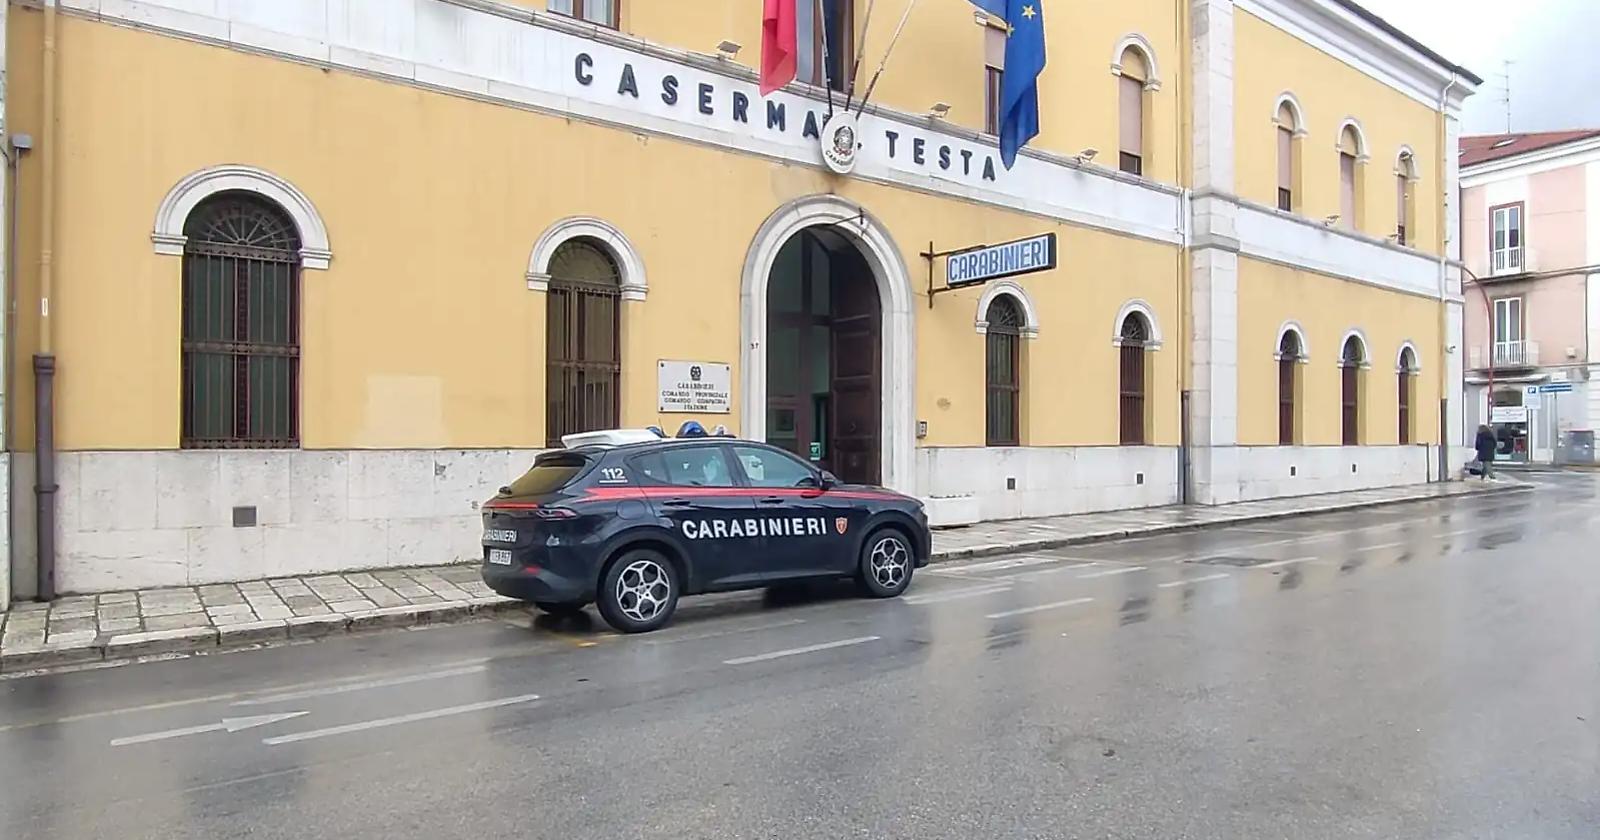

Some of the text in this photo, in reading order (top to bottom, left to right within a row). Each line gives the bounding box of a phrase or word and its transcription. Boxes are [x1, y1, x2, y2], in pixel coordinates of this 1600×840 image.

[575, 52, 819, 139] CASERMA
[885, 130, 996, 181] TESTA
[949, 238, 1047, 281] CARABINIERI
[601, 468, 625, 480] 112
[682, 517, 826, 539] CARABINIERI
